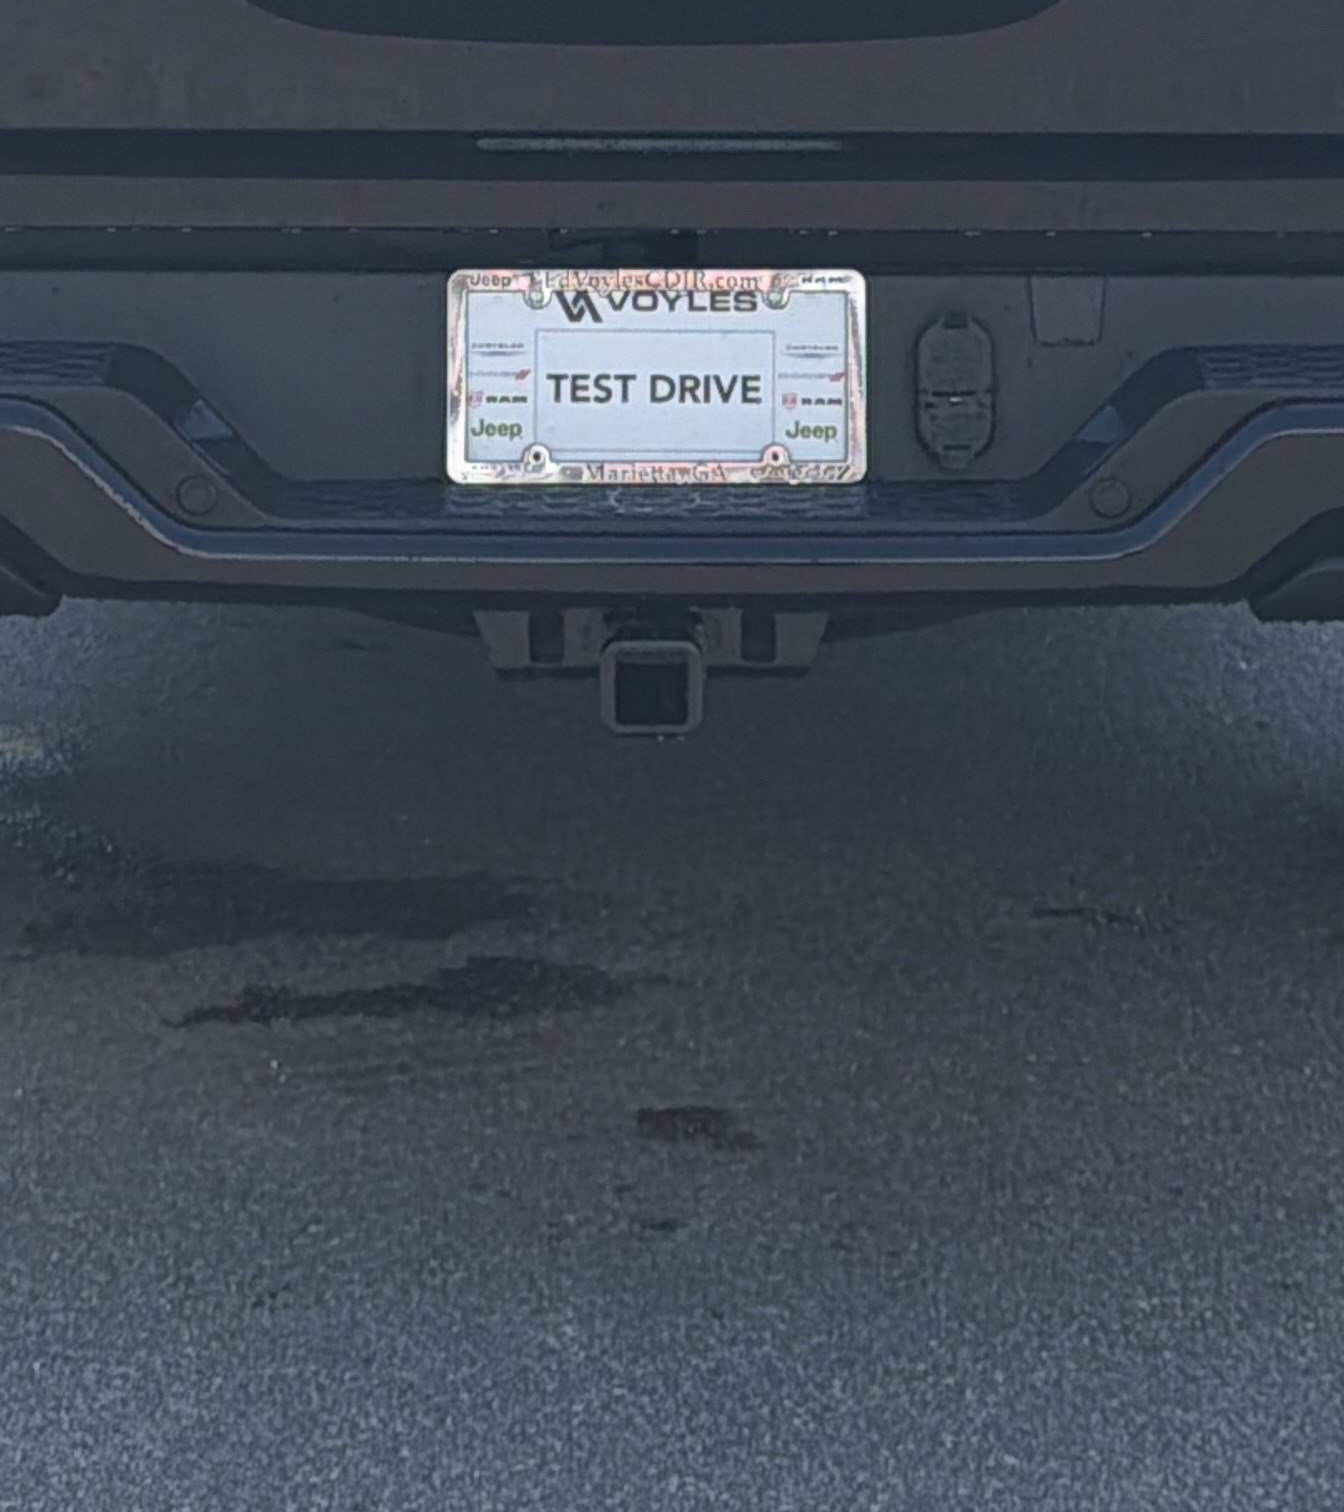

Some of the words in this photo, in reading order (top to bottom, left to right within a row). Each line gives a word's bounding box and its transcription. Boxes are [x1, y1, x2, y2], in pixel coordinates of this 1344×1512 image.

[608, 290, 758, 313] VOYLES
[546, 374, 637, 404] TEST
[649, 374, 762, 405] DRIVE
[470, 418, 523, 441] Jeep
[785, 419, 838, 443] Jeep
